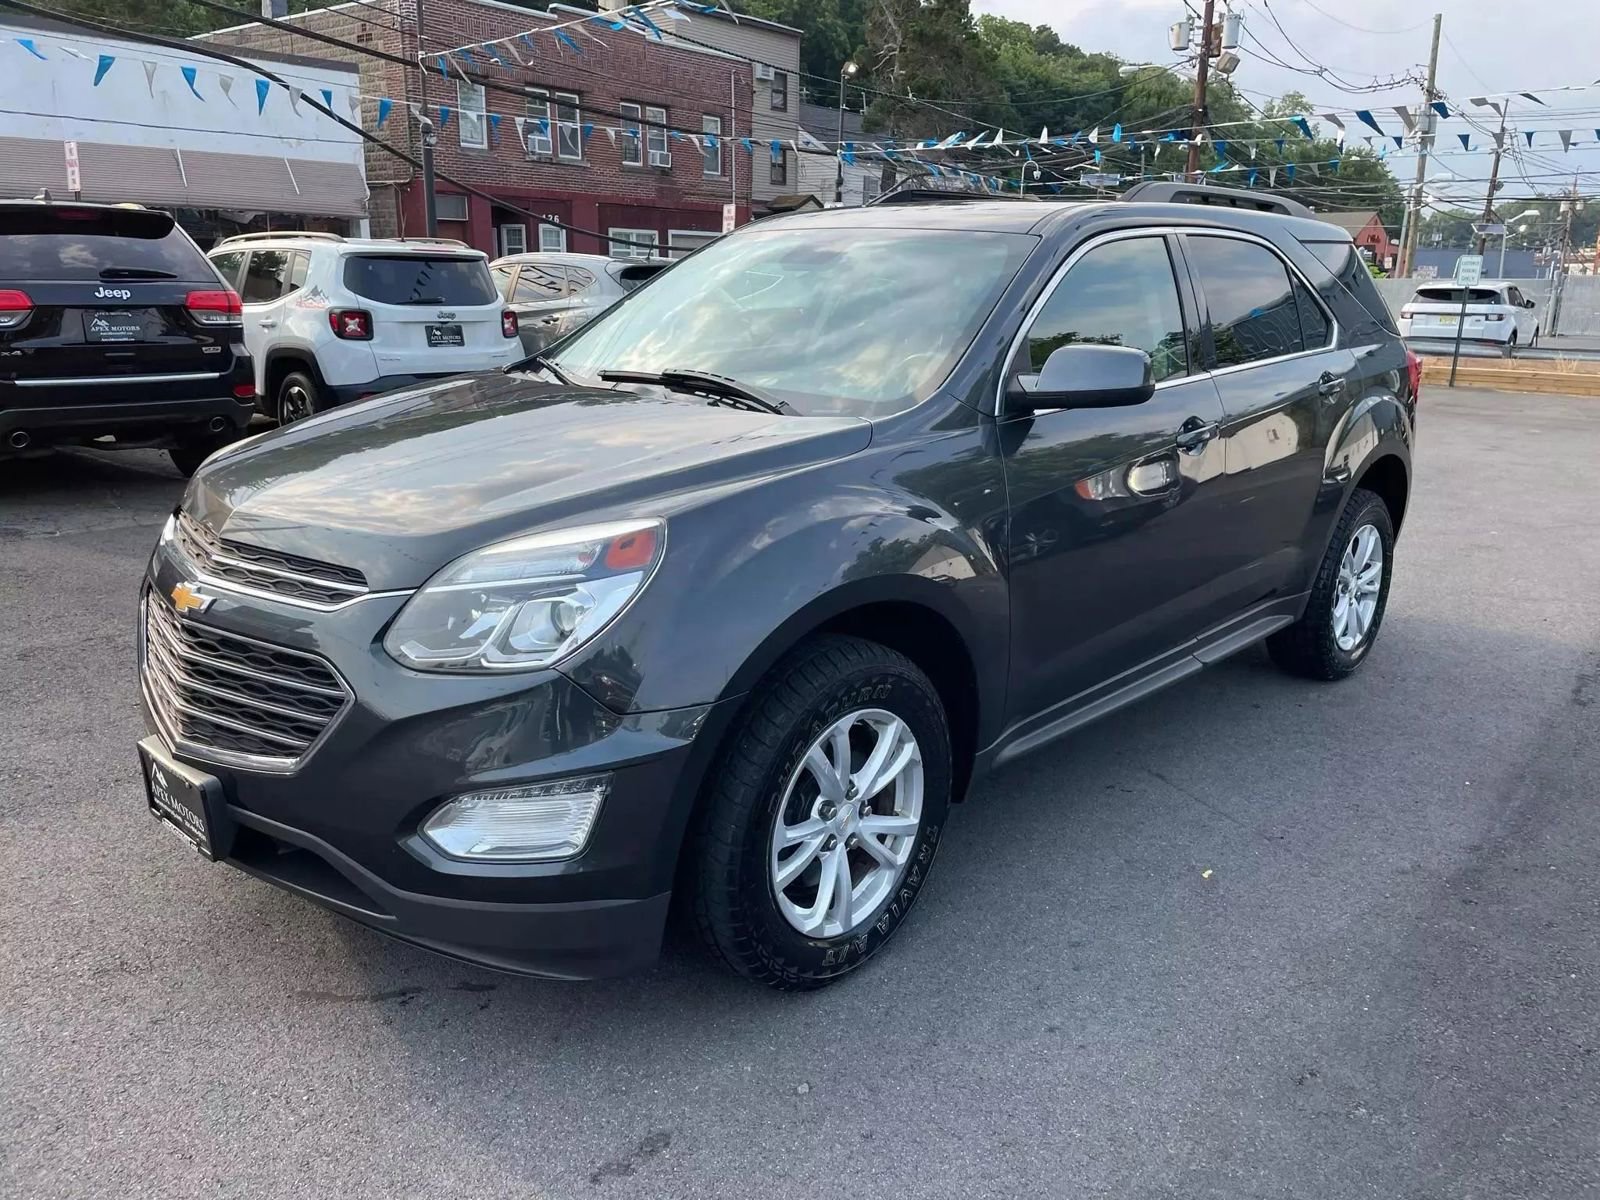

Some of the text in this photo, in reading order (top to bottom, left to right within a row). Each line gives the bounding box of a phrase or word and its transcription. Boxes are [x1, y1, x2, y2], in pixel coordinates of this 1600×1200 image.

[94, 286, 131, 300] Jeep
[151, 781, 170, 805] APEX
[170, 795, 206, 833] MOTORS
